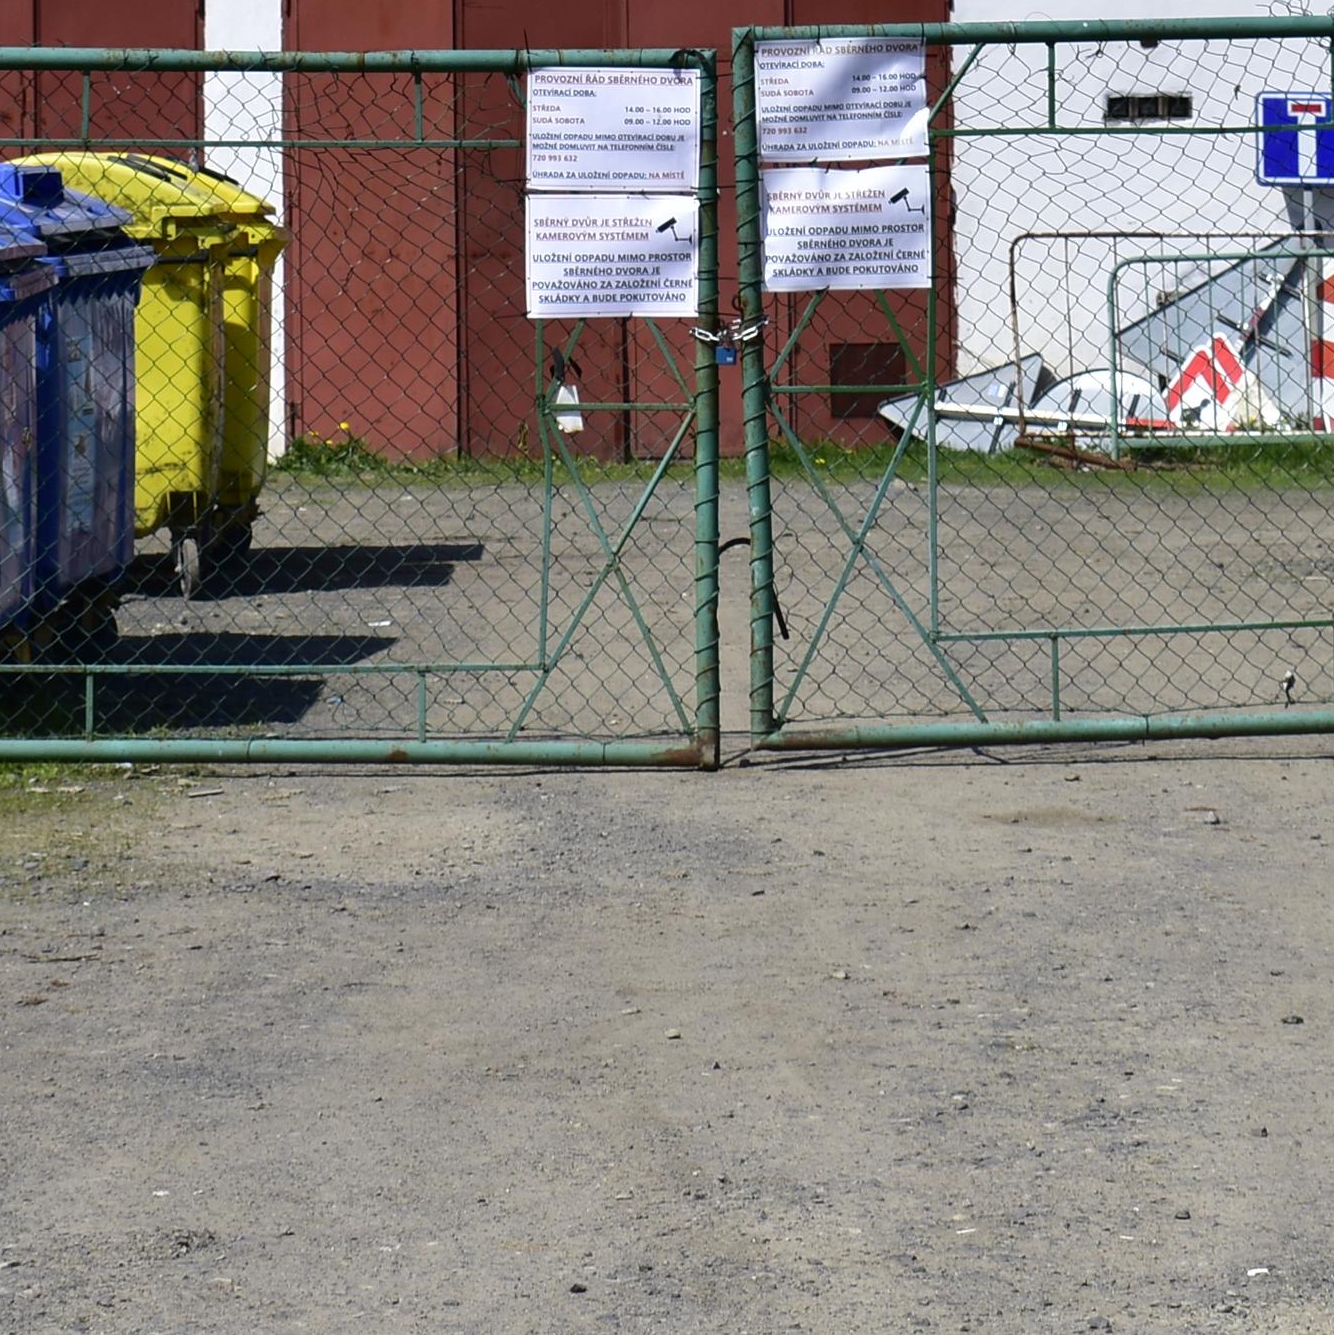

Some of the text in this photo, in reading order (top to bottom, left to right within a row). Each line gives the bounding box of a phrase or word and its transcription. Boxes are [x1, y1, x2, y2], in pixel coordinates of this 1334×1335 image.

[762, 47, 809, 56] PROVOZNÍ
[835, 44, 883, 54] SBĚRNÉHO
[886, 44, 917, 52] DVORA
[760, 61, 799, 69] OTEVÍRACÍ
[535, 74, 693, 85] PROVOZNÍ ŘÁD SBĚRNÉHO DVORA
[761, 77, 789, 85] STŘEDA
[533, 88, 571, 97] OTEVÍRACÍ
[761, 89, 782, 97] SUDÁ
[762, 105, 791, 114] ULOŽENÍ
[846, 101, 882, 110] OTEVÍRACÍ
[533, 116, 553, 124] SUDÁ
[762, 115, 788, 123] MOŽNÉ
[839, 112, 881, 120] TELEFONNÍM
[618, 133, 654, 141] OTEVÍRACÍ
[560, 143, 596, 151] DOMLUVIT
[610, 143, 654, 151] TELEFONNÍM
[656, 143, 675, 151] ČÍSLE:
[762, 142, 795, 151] ÚHRADA
[809, 141, 840, 149] ULOŽENÍ
[533, 170, 564, 178] ÚHRADA
[578, 171, 610, 179] ULOŽENÍ
[662, 171, 684, 179] MÍSTĚ
[768, 191, 802, 201] SBĚRNÝ
[806, 189, 830, 199] DVŮR
[846, 189, 885, 199] STŘEŽEN
[770, 203, 882, 215] KAMEROVÝM SYSTÉMEM
[534, 217, 652, 227] SBĚRNÝ DVŮR JE STŘEŽEN
[768, 224, 924, 235] ULOŽENÍ ODPADU MIMO PROSTOR
[536, 231, 649, 241] KAMEROVÝM SYSTÉMEM
[797, 238, 893, 249] SBĚRNÉHO DVORA JE
[533, 253, 571, 262] ULOŽENÍ
[575, 254, 614, 262] ODPADU
[649, 253, 691, 261] PROSTOR
[767, 252, 832, 263] POVAŽOVÁNO
[848, 250, 894, 259] ZALOŽENÍ
[896, 250, 925, 259] ČERNÉ
[563, 266, 660, 276] SBĚRNÉHO DVORA JE
[773, 266, 815, 277] SKLÁDKY
[853, 264, 919, 274] POKUTOVÁNO
[532, 279, 597, 289] POVAŽOVÁNO
[615, 279, 660, 288] ZALOŽENÍ
[663, 278, 693, 288] ČERNÉ
[539, 293, 580, 303] SKLÁDKY
[620, 292, 686, 301] POKUTOVÁNO
